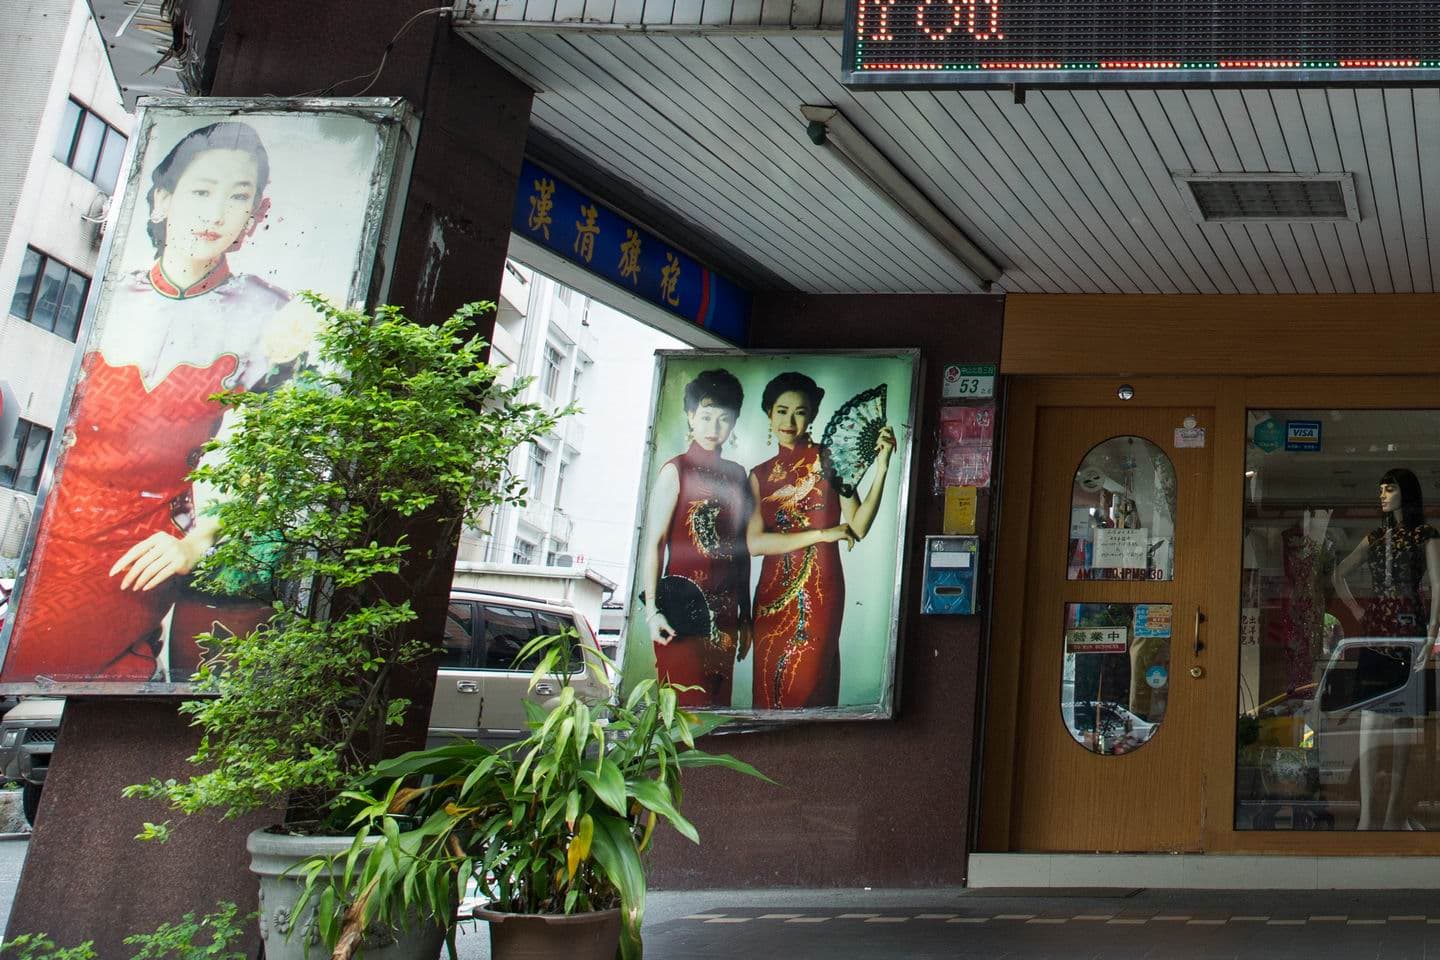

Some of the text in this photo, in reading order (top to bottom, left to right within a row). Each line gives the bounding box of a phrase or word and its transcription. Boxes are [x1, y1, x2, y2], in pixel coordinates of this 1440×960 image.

[528, 177, 681, 307] 漢清旗袍
[959, 379, 979, 394] 53
[1293, 429, 1314, 437] VISA
[1073, 631, 1120, 642] 營業中
